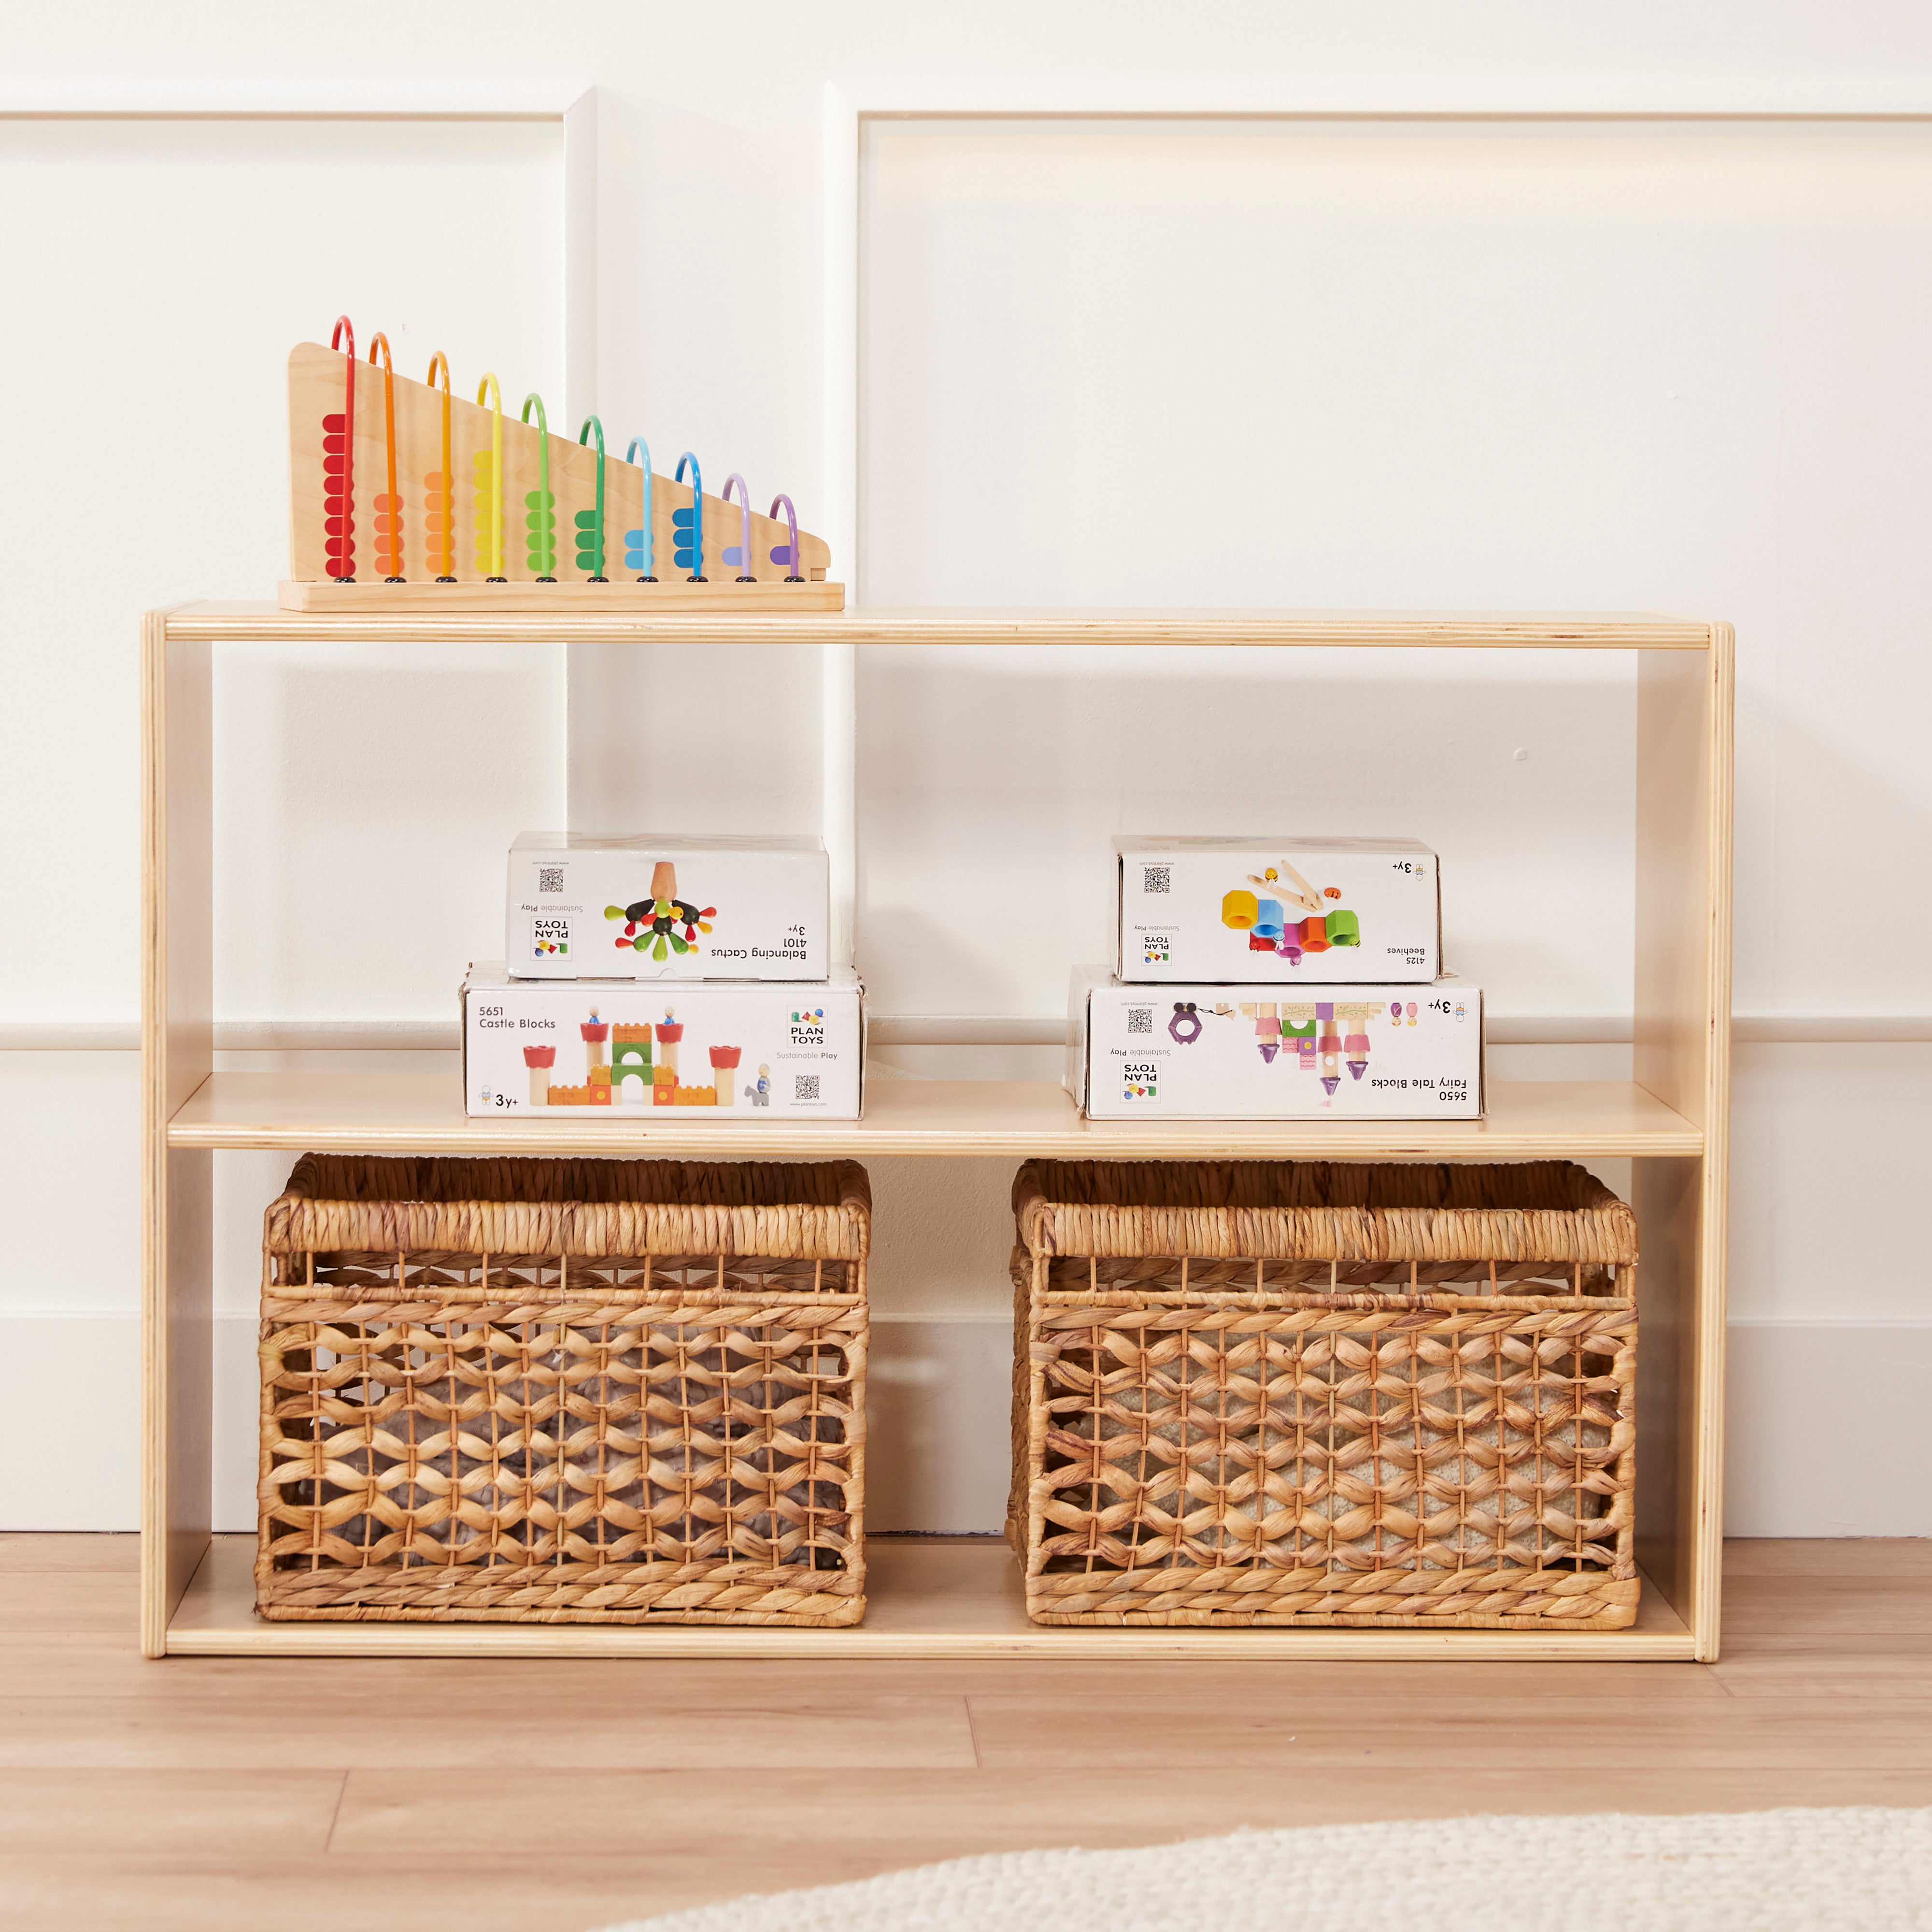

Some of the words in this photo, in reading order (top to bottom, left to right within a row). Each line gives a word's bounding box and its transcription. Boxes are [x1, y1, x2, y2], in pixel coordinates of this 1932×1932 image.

[1392, 861, 1411, 873] 3y+
[521, 904, 538, 912] Play
[535, 921, 568, 929] TOYS
[788, 924, 805, 936] 3y+
[784, 938, 807, 947] 4101
[711, 950, 747, 959] Cactus
[752, 948, 806, 960] Balancing
[1428, 998, 1450, 1013] 3y+
[480, 1007, 503, 1016] 5651
[480, 1019, 514, 1028] Castle
[520, 1019, 555, 1028] Blocks
[1372, 1080, 1407, 1089] Blocks
[1412, 1080, 1435, 1089] Tale
[1439, 1077, 1466, 1089] Fairy
[496, 1094, 518, 1108] 3y+
[1439, 1092, 1467, 1101] 5650
